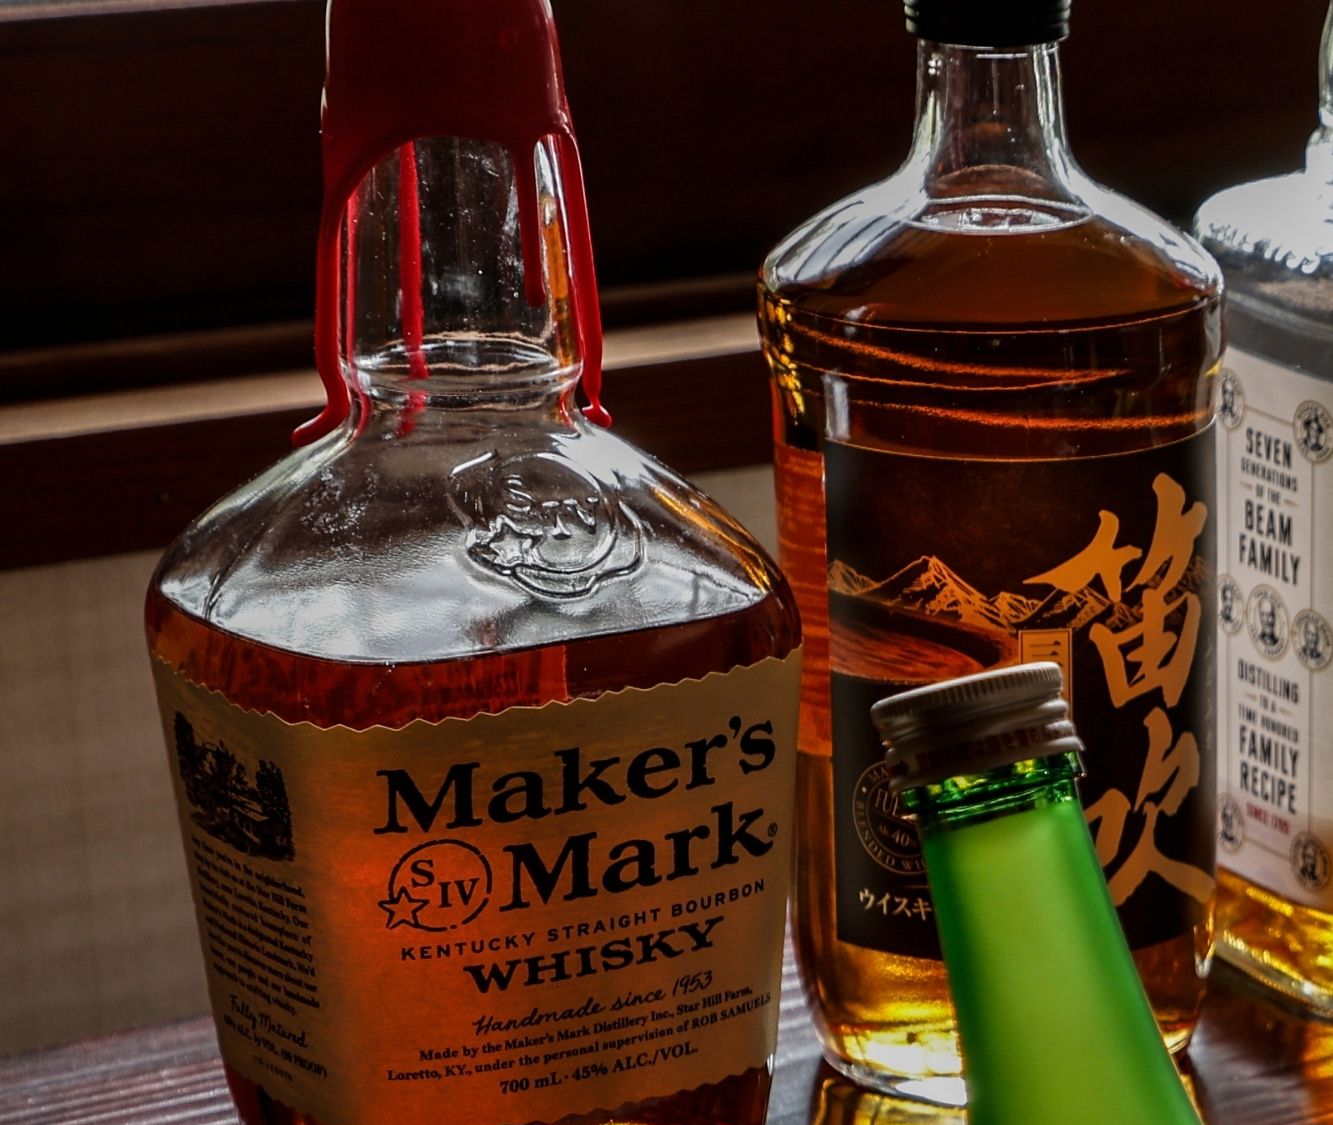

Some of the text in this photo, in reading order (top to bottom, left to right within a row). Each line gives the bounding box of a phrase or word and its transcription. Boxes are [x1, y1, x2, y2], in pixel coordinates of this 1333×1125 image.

[1240, 456, 1298, 492] GENERATIONS
[1246, 426, 1292, 469] SEVEN
[1255, 484, 1281, 505] OF THE
[1244, 499, 1294, 547] BEAM
[1238, 534, 1300, 586] FAMILY
[1237, 658, 1300, 703] DISTILLING
[1238, 703, 1299, 744] TIME HONORED
[374, 715, 776, 834] Maker's
[1239, 725, 1300, 779] FAMILY
[1240, 760, 1297, 815] RECIPE
[401, 879, 765, 961] KENTUCKY STRAIGHT BOURBON
[464, 916, 724, 994] WHISKY
[229, 994, 256, 1029] Fully
[419, 1047, 459, 1062] Made
[462, 1046, 479, 1060] by
[482, 1041, 502, 1054] the
[504, 1033, 555, 1052] Maker's
[557, 1025, 590, 1043] Mark
[593, 1011, 648, 1036] Distillery
[676, 1001, 699, 1016] Star
[702, 993, 722, 1011] Hill
[725, 987, 753, 1005] Farm,
[472, 969, 714, 1036] Handmade since 1953
[387, 1066, 441, 1083] Loretto,
[475, 1058, 515, 1074] under
[519, 1054, 541, 1067] the
[544, 1042, 600, 1066] personal
[602, 1025, 673, 1053] supervision
[676, 1021, 689, 1034] of
[692, 1013, 719, 1029] ROB
[720, 992, 772, 1022] SAMUELS
[500, 1078, 531, 1095] 700
[612, 1040, 699, 1076] ALC./VOL.
